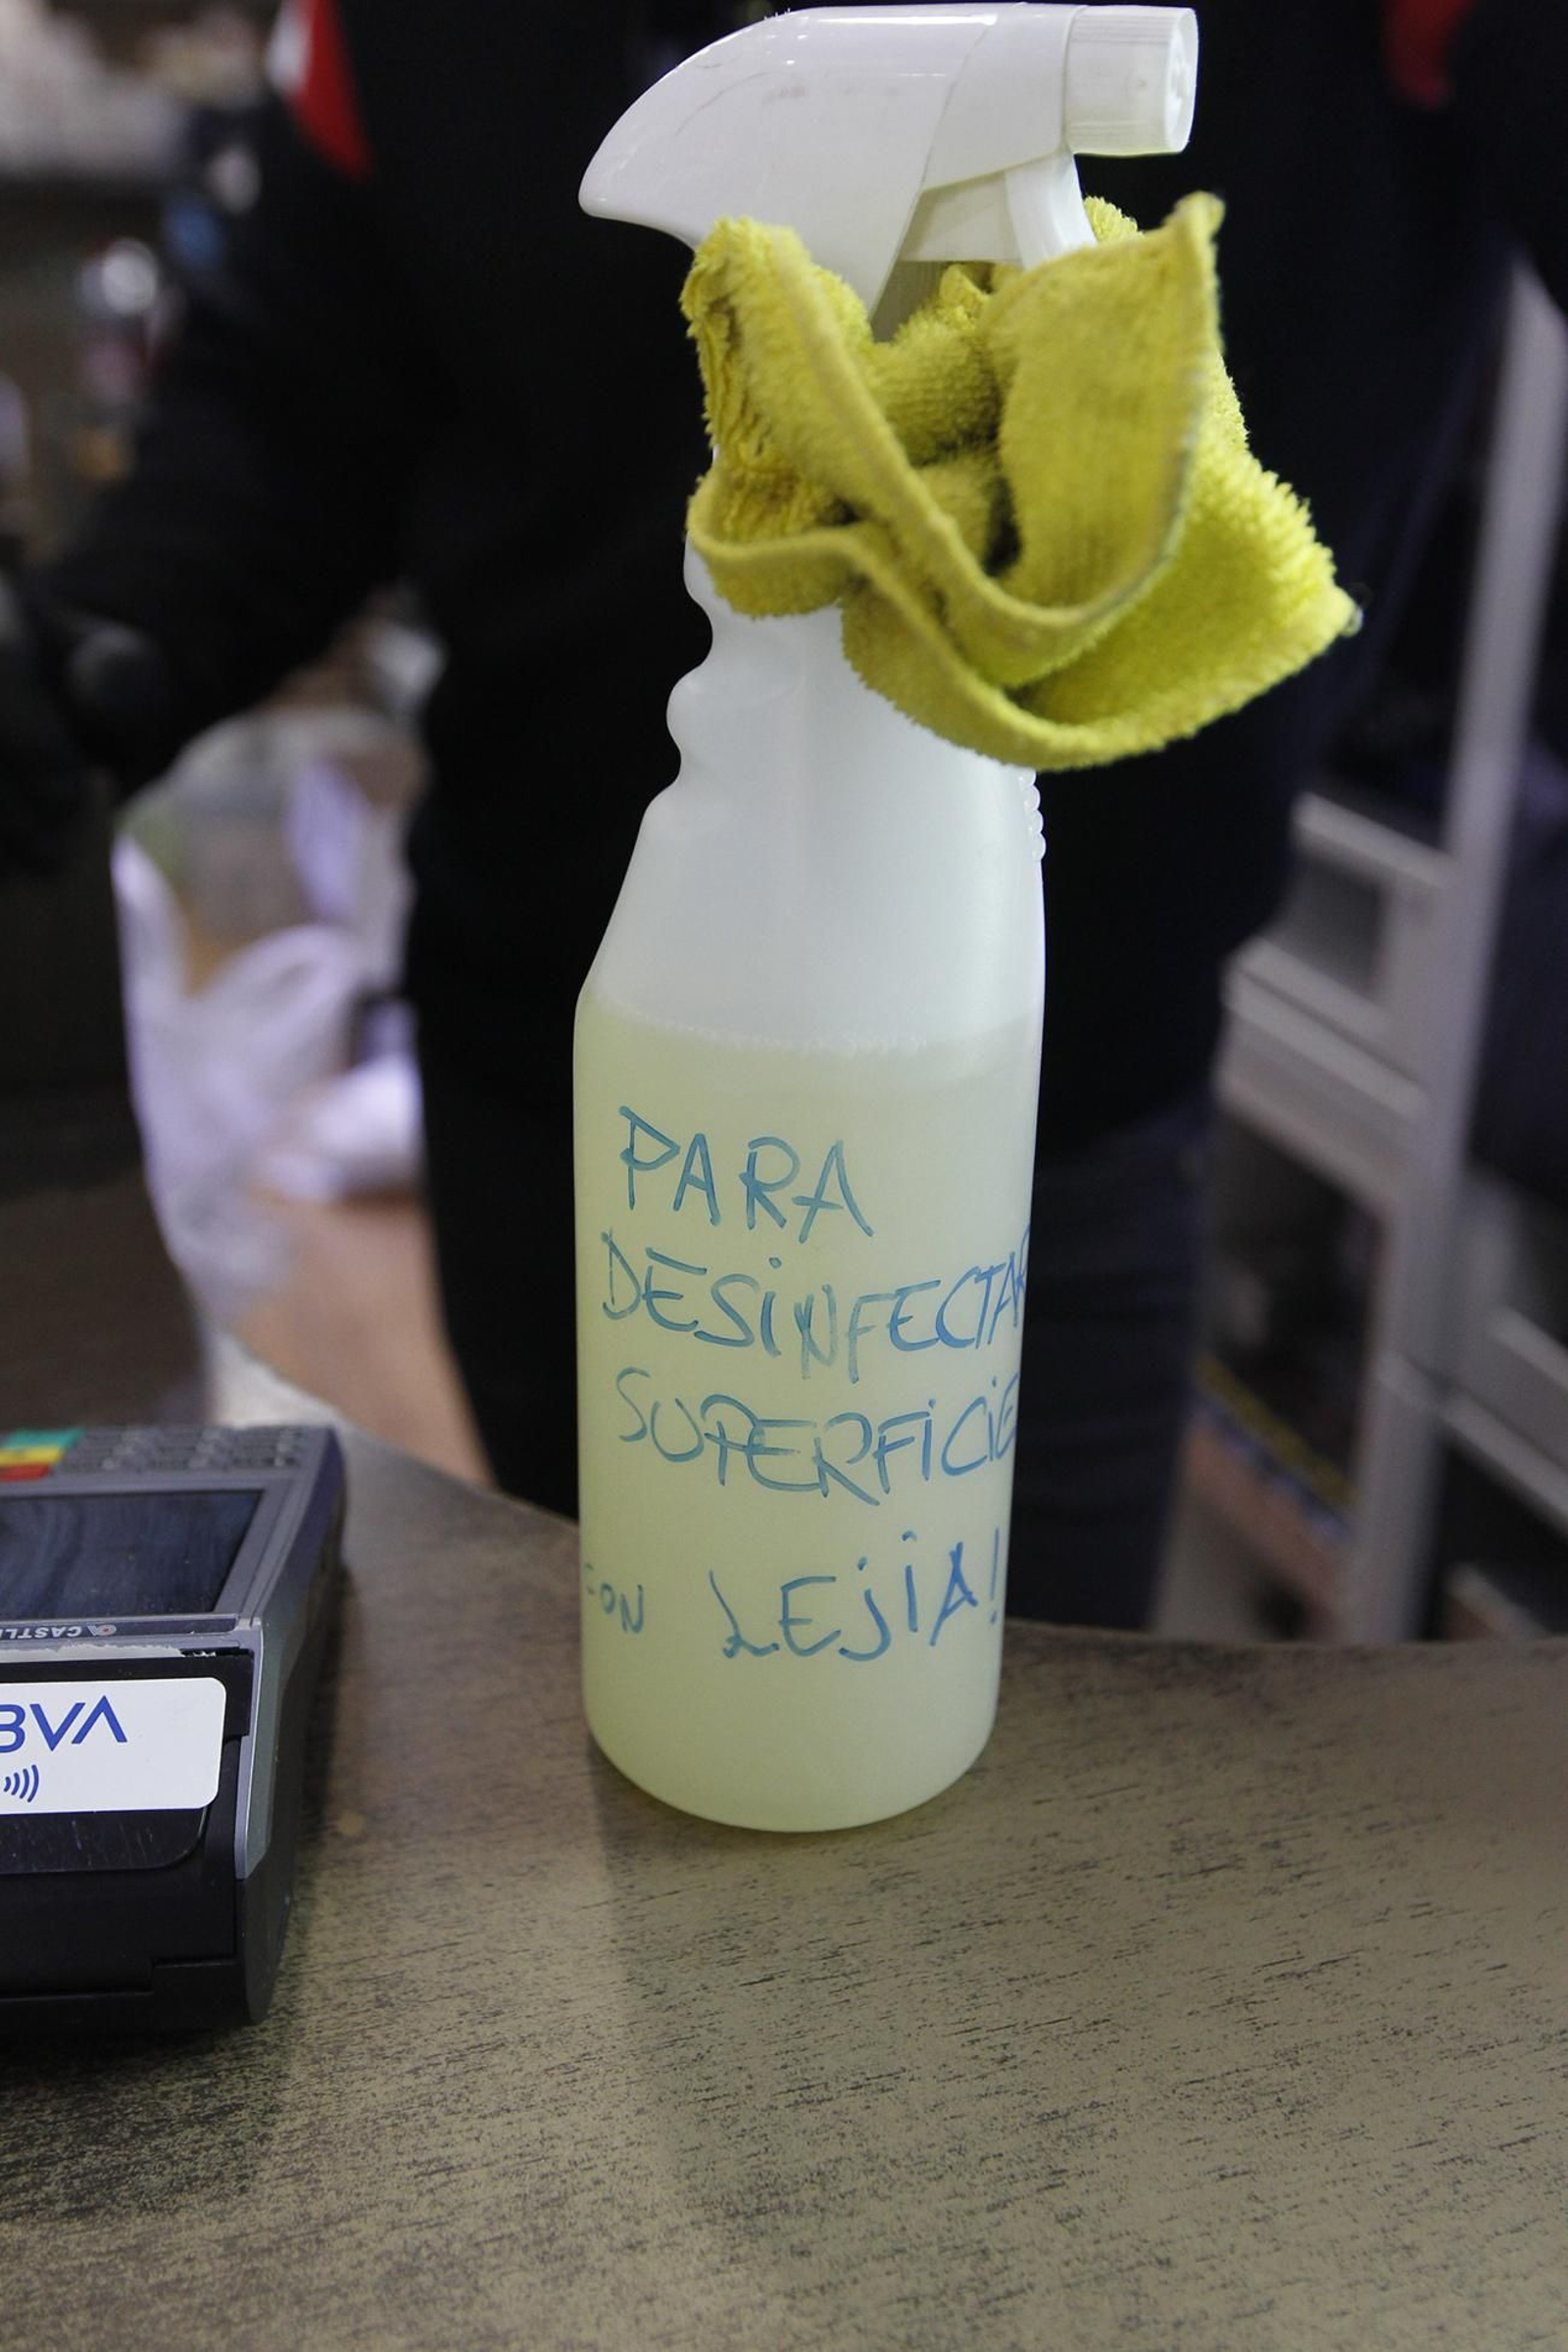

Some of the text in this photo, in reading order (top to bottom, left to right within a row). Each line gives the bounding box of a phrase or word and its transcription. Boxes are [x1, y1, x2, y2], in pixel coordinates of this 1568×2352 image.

[618, 1105, 875, 1244] PARA
[585, 1562, 645, 1635] ON
[0, 1625, 82, 1640] CASTL
[0, 1694, 128, 1754] BVA
